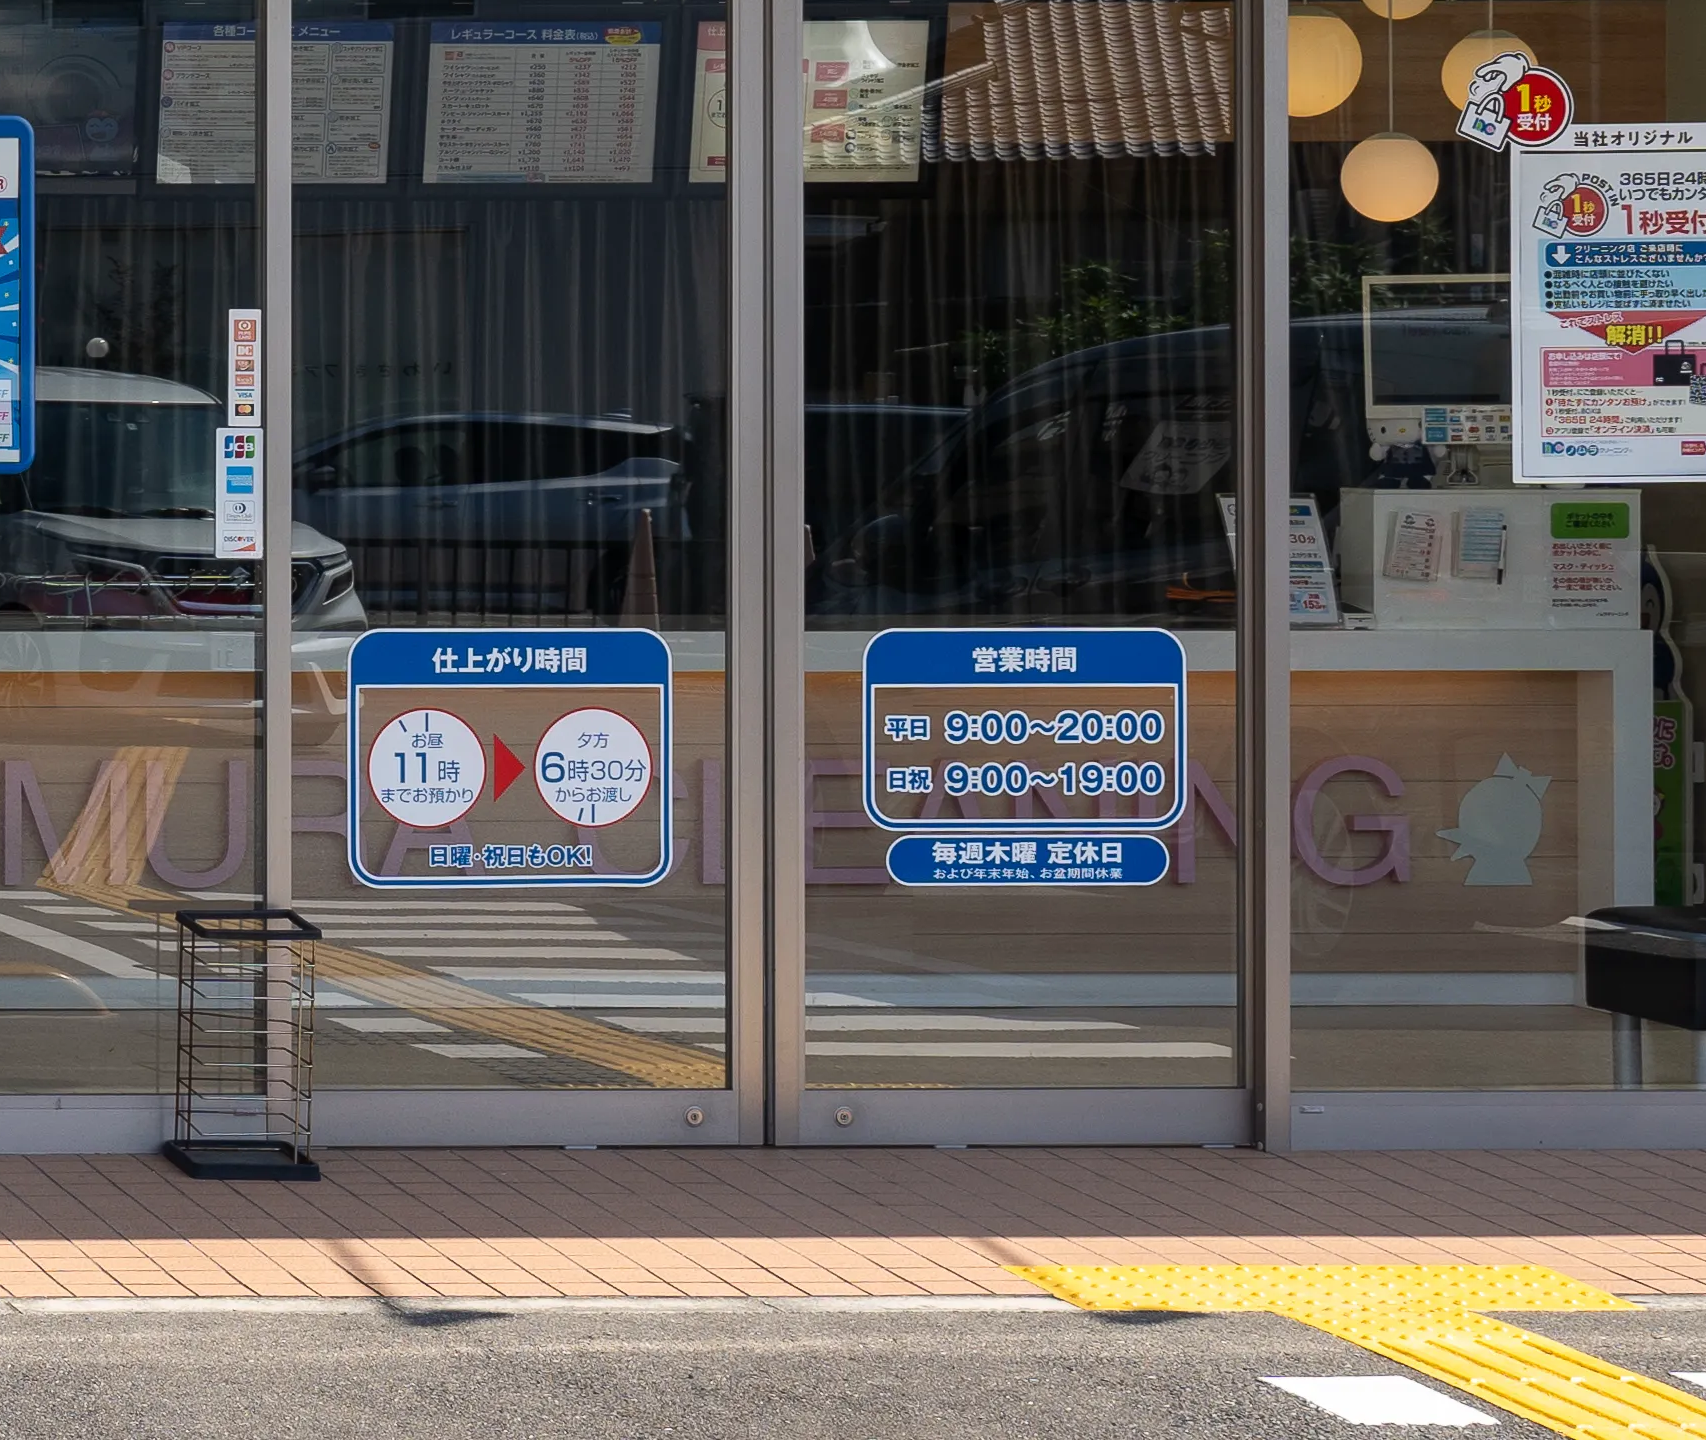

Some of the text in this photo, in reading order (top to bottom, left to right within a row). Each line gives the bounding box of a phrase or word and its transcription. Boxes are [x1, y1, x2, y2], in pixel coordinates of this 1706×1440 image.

[298, 27, 340, 36] メニュー
[451, 29, 537, 40] レギュラーコース
[1516, 84, 1552, 113] 1秒
[1516, 113, 1552, 132] 受付
[1573, 130, 1693, 147] 当社オリジナル
[1581, 173, 1613, 195] POST
[1571, 194, 1595, 213] 1秒
[1572, 213, 1595, 226] 受付
[1560, 312, 1624, 328] これでストレス
[224, 440, 255, 454] JCB
[432, 647, 587, 673] 仕上がり時間
[972, 647, 1078, 673] 営業時間
[885, 715, 930, 741] 平日
[411, 733, 443, 748] お昼
[577, 733, 610, 748] 夕方
[541, 751, 647, 783] 6時30分
[886, 766, 933, 793] 日祝
[381, 788, 474, 803] までお預かり
[555, 787, 632, 803] からお渡し
[932, 842, 1123, 864] 毎週木曜 定休日
